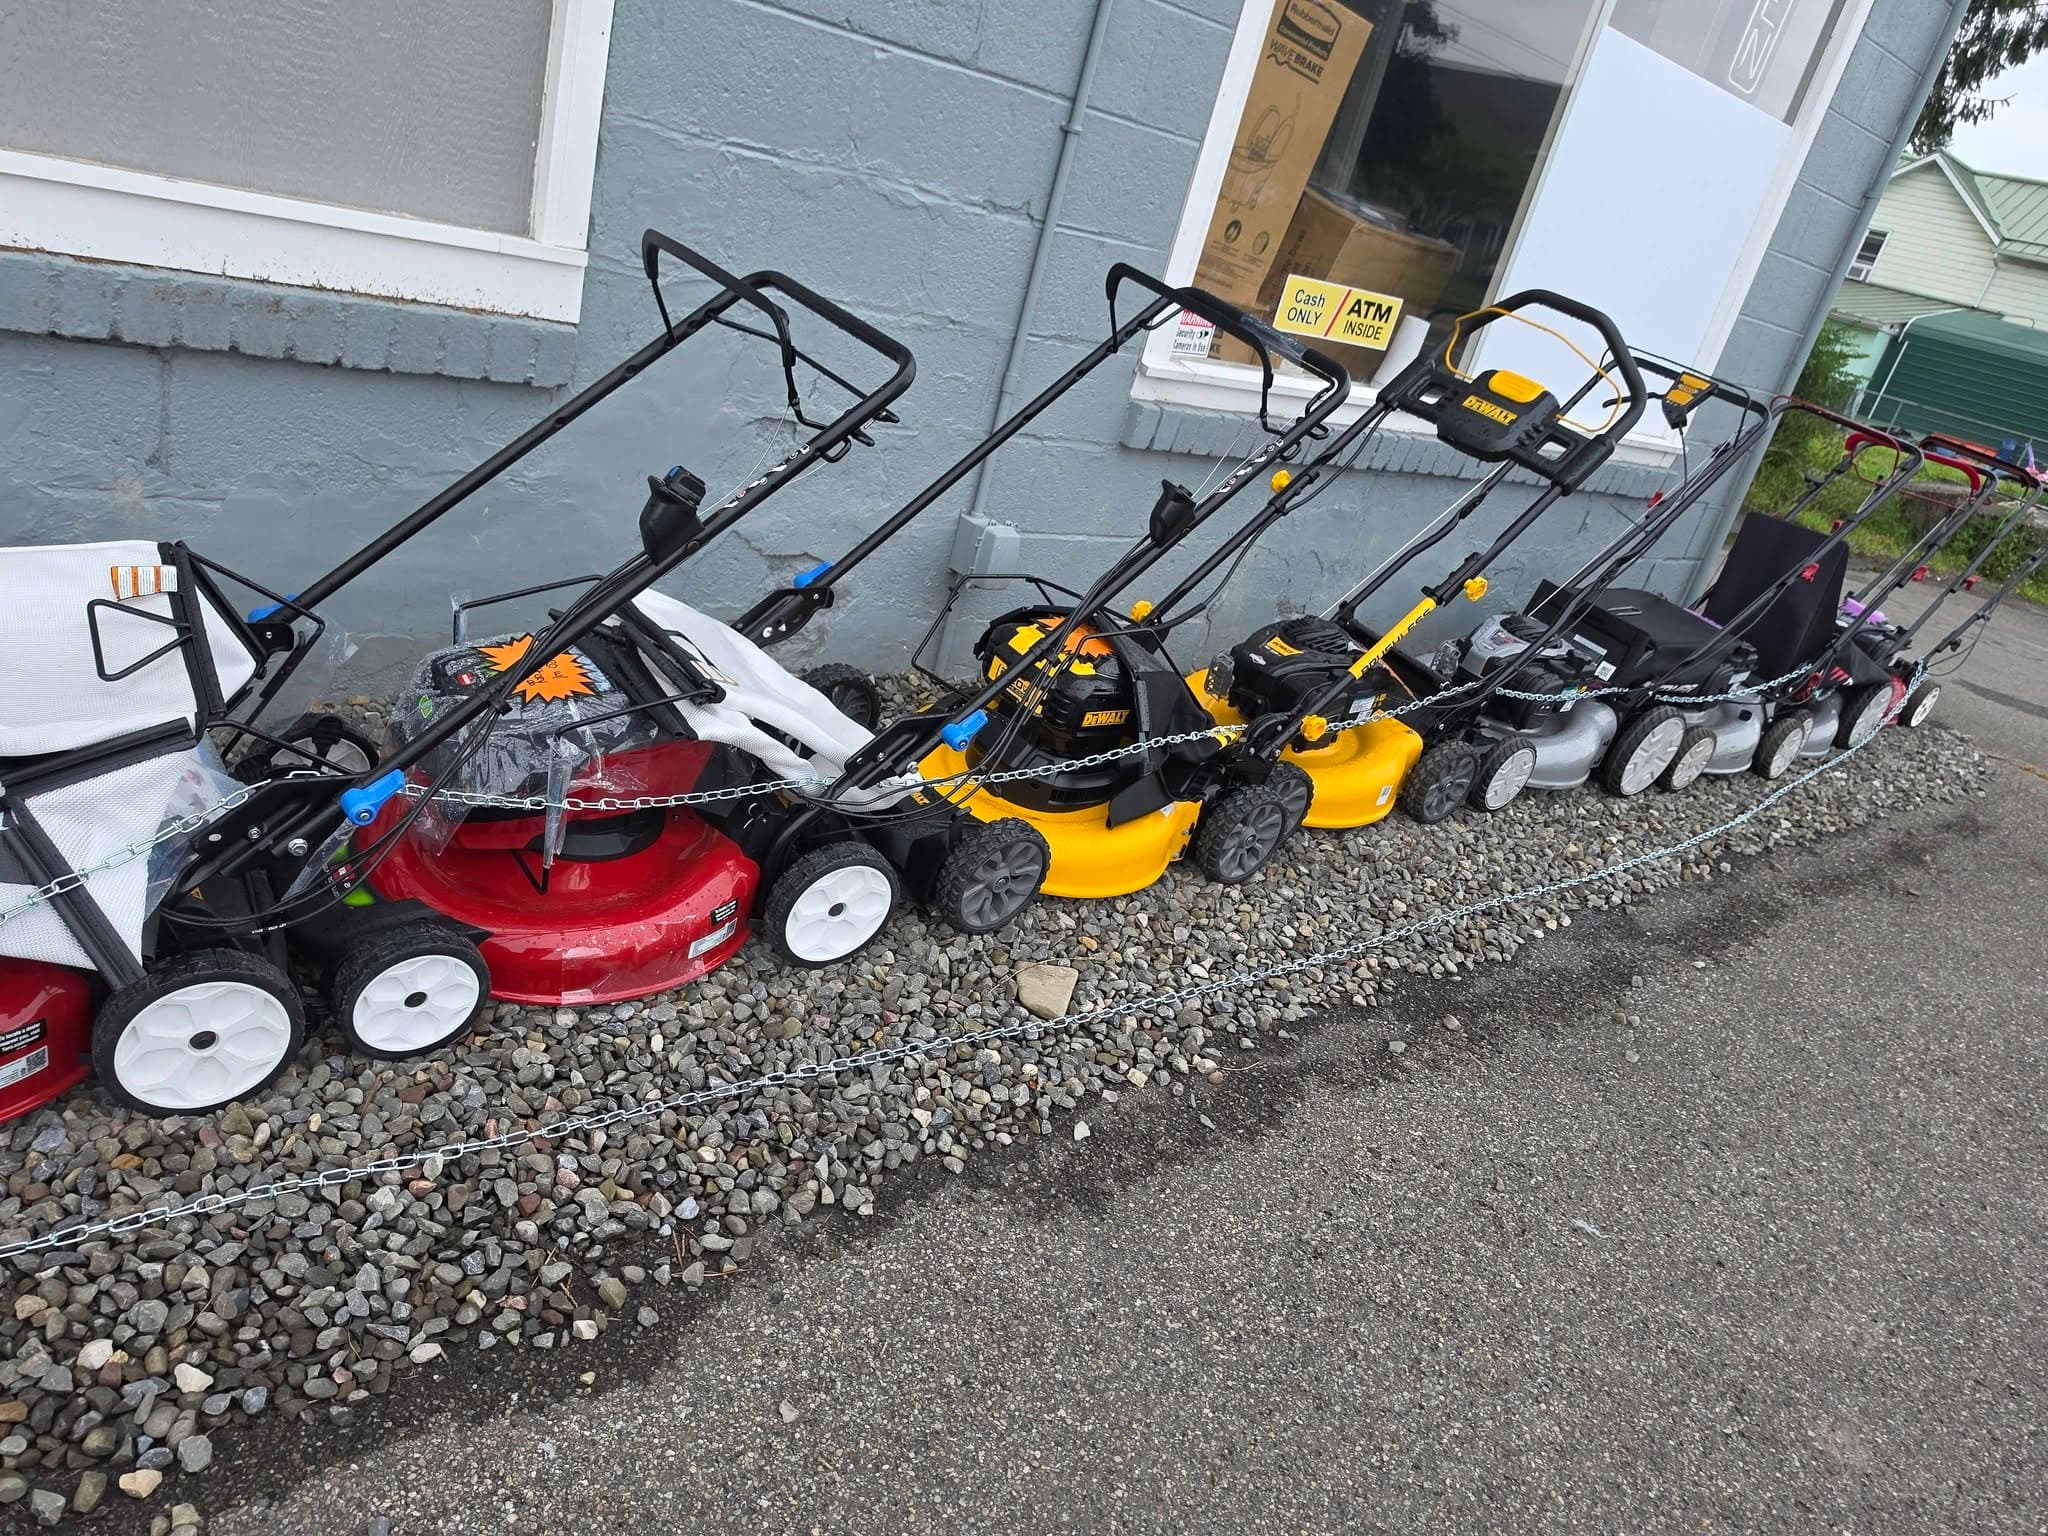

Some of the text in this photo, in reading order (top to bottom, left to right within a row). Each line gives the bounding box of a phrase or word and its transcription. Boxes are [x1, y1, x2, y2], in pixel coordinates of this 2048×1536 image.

[1290, 2, 1336, 37] Rubbermaid
[1295, 289, 1325, 308] Cash
[1287, 306, 1323, 327] ONLY
[1347, 298, 1393, 324] ATM
[1176, 327, 1195, 341] Security
[1343, 320, 1384, 341] INSIDE
[1173, 339, 1192, 351] Cameras
[1197, 341, 1207, 353] Use
